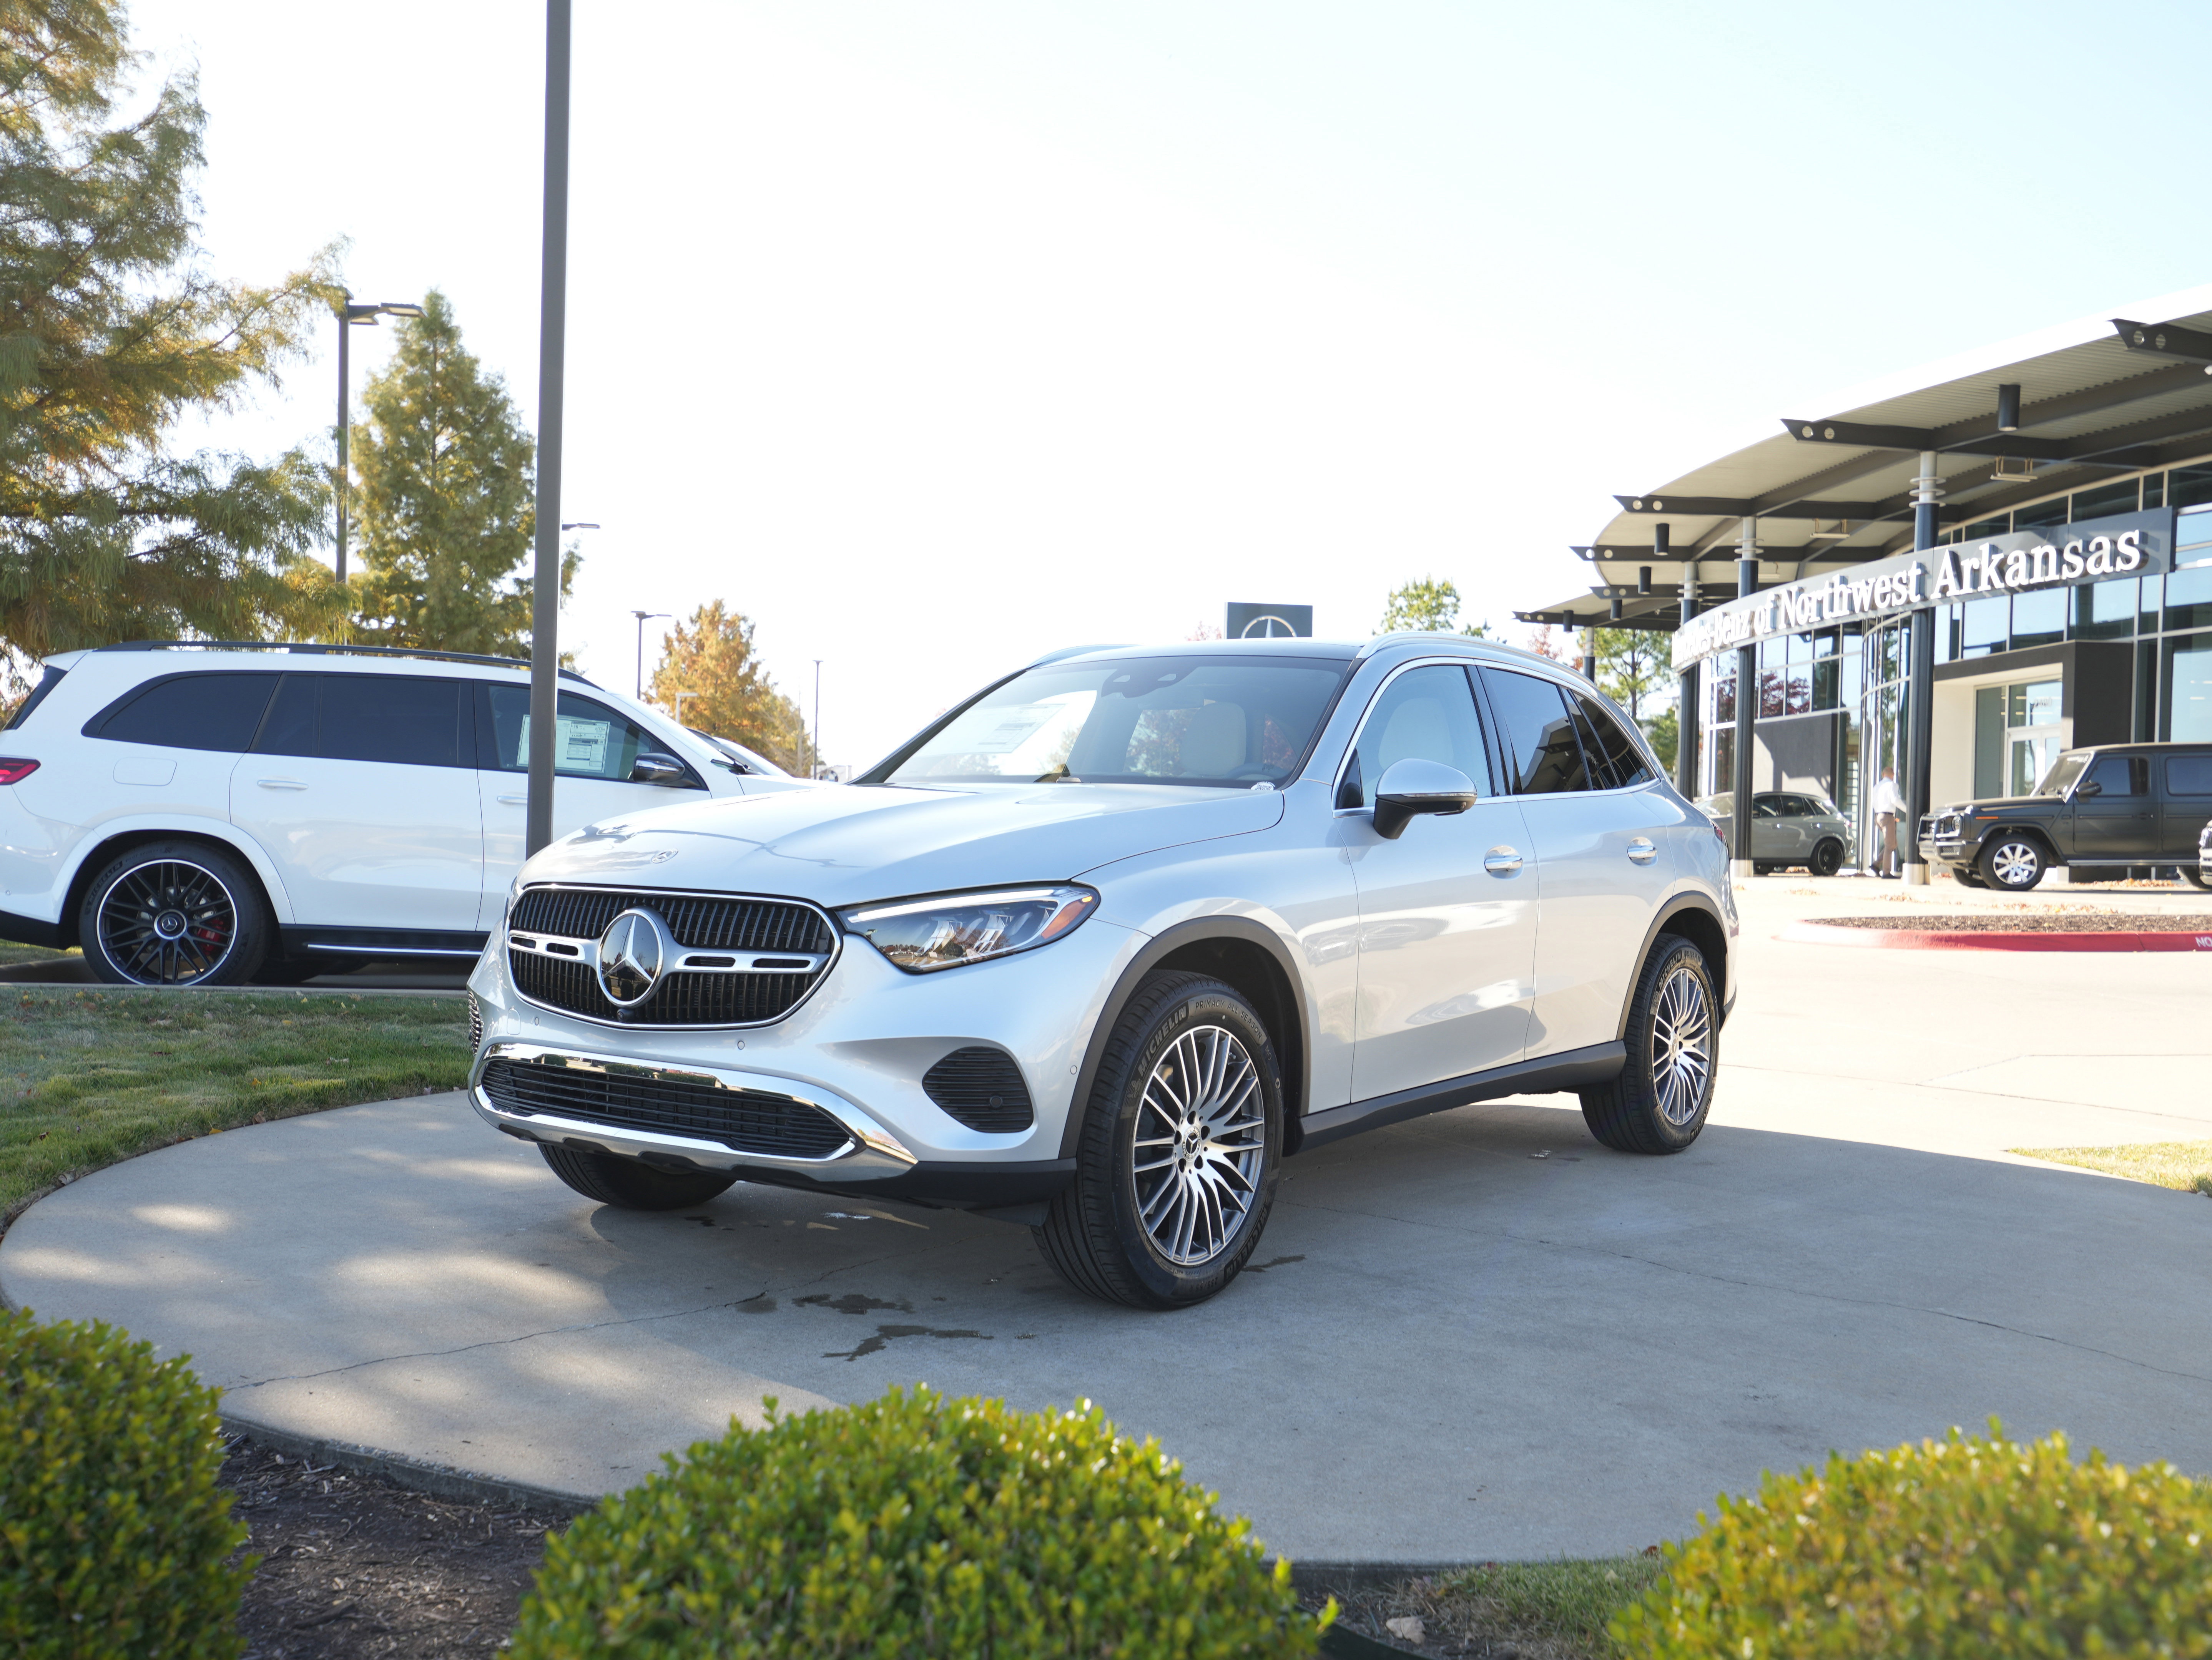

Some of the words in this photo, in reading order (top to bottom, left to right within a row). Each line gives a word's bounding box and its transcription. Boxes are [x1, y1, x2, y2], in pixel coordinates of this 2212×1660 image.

[1754, 592, 1774, 635] of
[1778, 561, 1921, 629] Northwest
[1930, 530, 2140, 599] Arkansas
[1659, 951, 1681, 990] MICHELIN
[1195, 999, 1225, 1011] PRIMACY
[1227, 1003, 1238, 1014] ALL
[1241, 1011, 1262, 1039] SEASON
[1138, 1006, 1187, 1077] MICHELIN
[1265, 1045, 1272, 1060] MO
[1656, 1111, 1667, 1132] SEASON
[1226, 1207, 1268, 1278] MICHELIN
